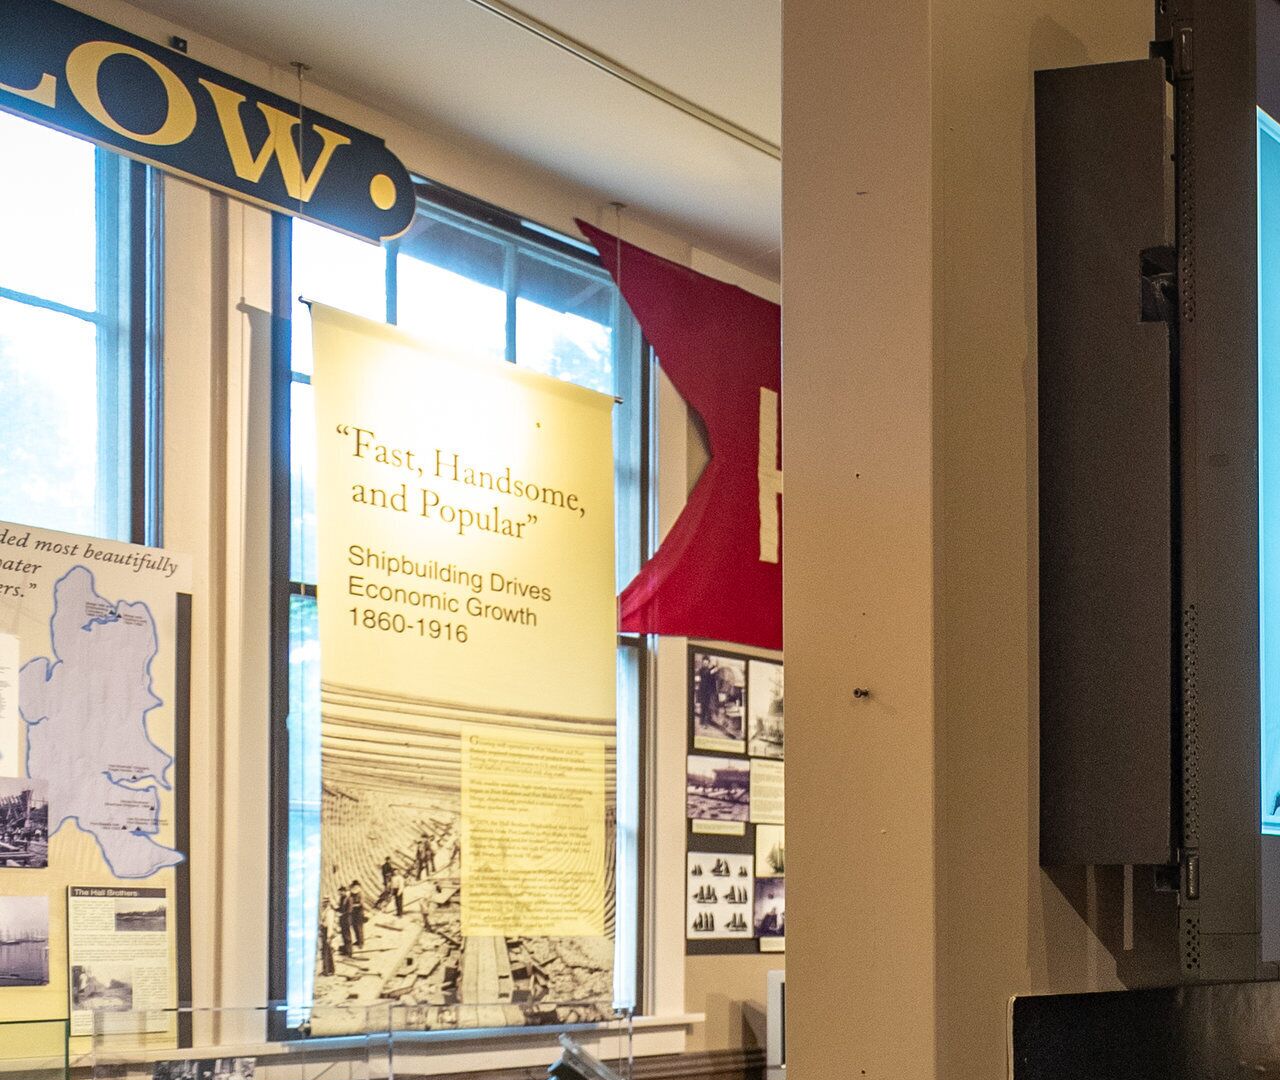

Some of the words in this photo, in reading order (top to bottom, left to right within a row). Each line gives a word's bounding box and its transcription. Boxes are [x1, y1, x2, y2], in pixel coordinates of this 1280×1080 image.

[336, 423, 423, 477] “Fast,
[435, 449, 586, 518] Handsome,
[352, 483, 408, 513] and
[420, 488, 538, 539] Popular”
[0, 557, 42, 575] ater
[35, 540, 79, 556] most
[83, 543, 178, 578] beautifully
[348, 545, 482, 593] Shipbuilding
[490, 573, 552, 602] Drives
[348, 575, 459, 613] Economic
[466, 597, 537, 626] Growth
[349, 607, 468, 644] 1860-1916
